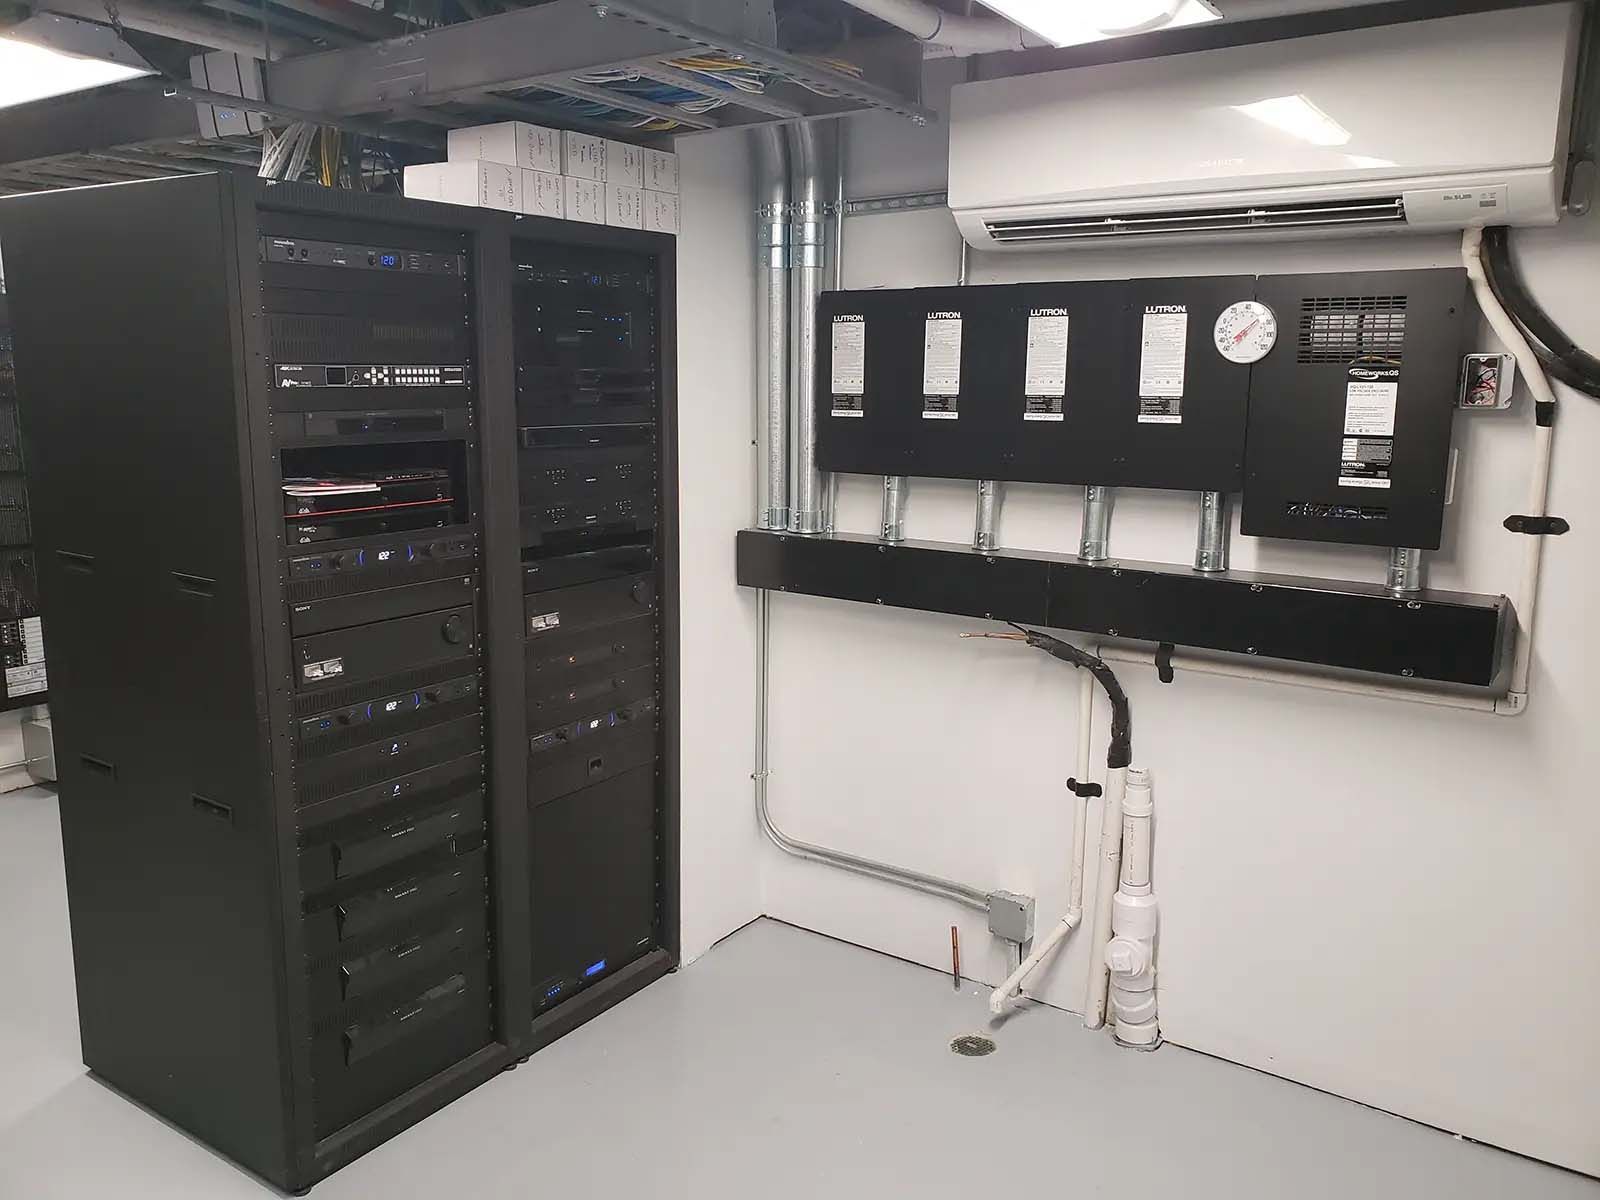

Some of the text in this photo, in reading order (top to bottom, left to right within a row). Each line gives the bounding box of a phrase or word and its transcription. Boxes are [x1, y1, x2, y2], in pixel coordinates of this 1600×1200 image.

[380, 255, 394, 265] 120
[1030, 308, 1067, 316] LUTRON
[1145, 304, 1187, 313] LUTRON
[833, 314, 864, 322] LUTRON
[927, 311, 961, 319] LUTRON
